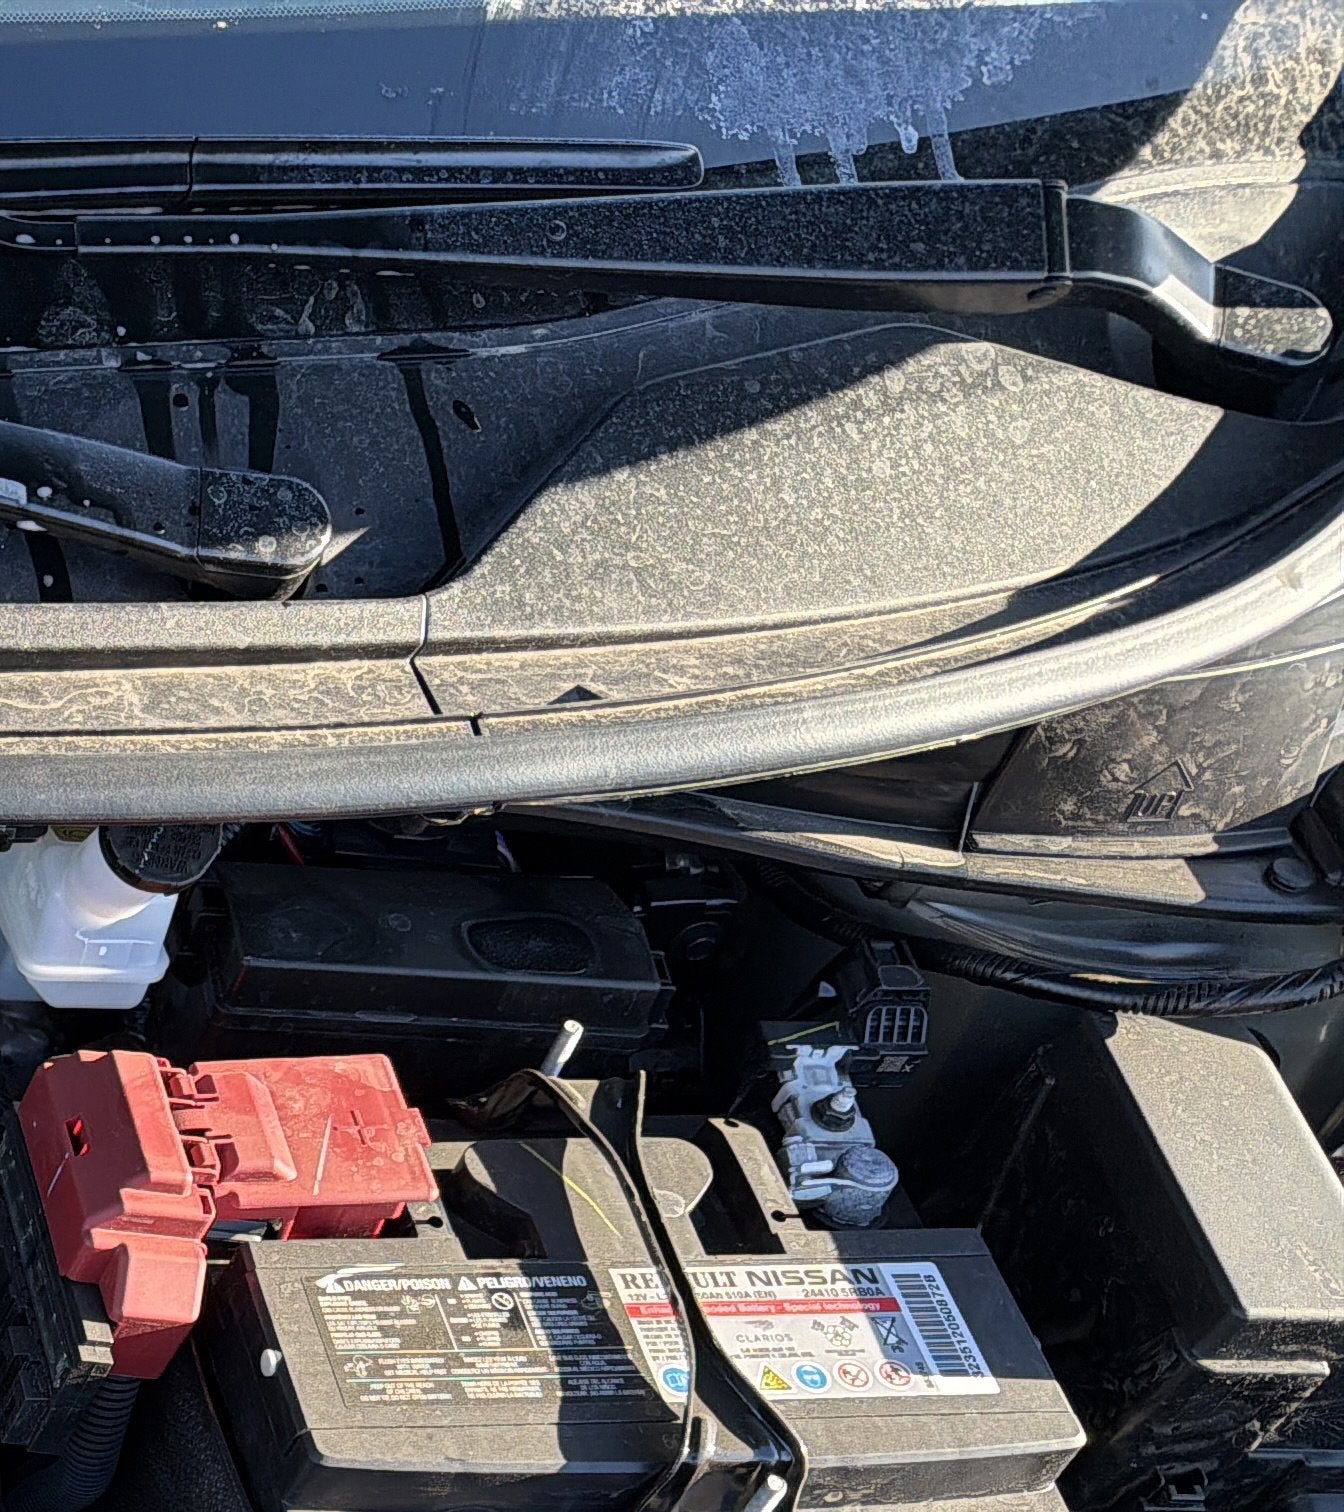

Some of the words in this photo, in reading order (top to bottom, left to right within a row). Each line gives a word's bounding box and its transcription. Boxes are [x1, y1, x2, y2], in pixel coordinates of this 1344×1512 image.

[477, 1275, 588, 1289] PELIGRO/VENENO
[744, 1267, 880, 1287] NISSAN
[343, 1279, 452, 1292] DANGER/POISON
[802, 1288, 840, 1298] 24410
[823, 1300, 881, 1312] technology
[735, 1333, 794, 1343] CLARIOS
